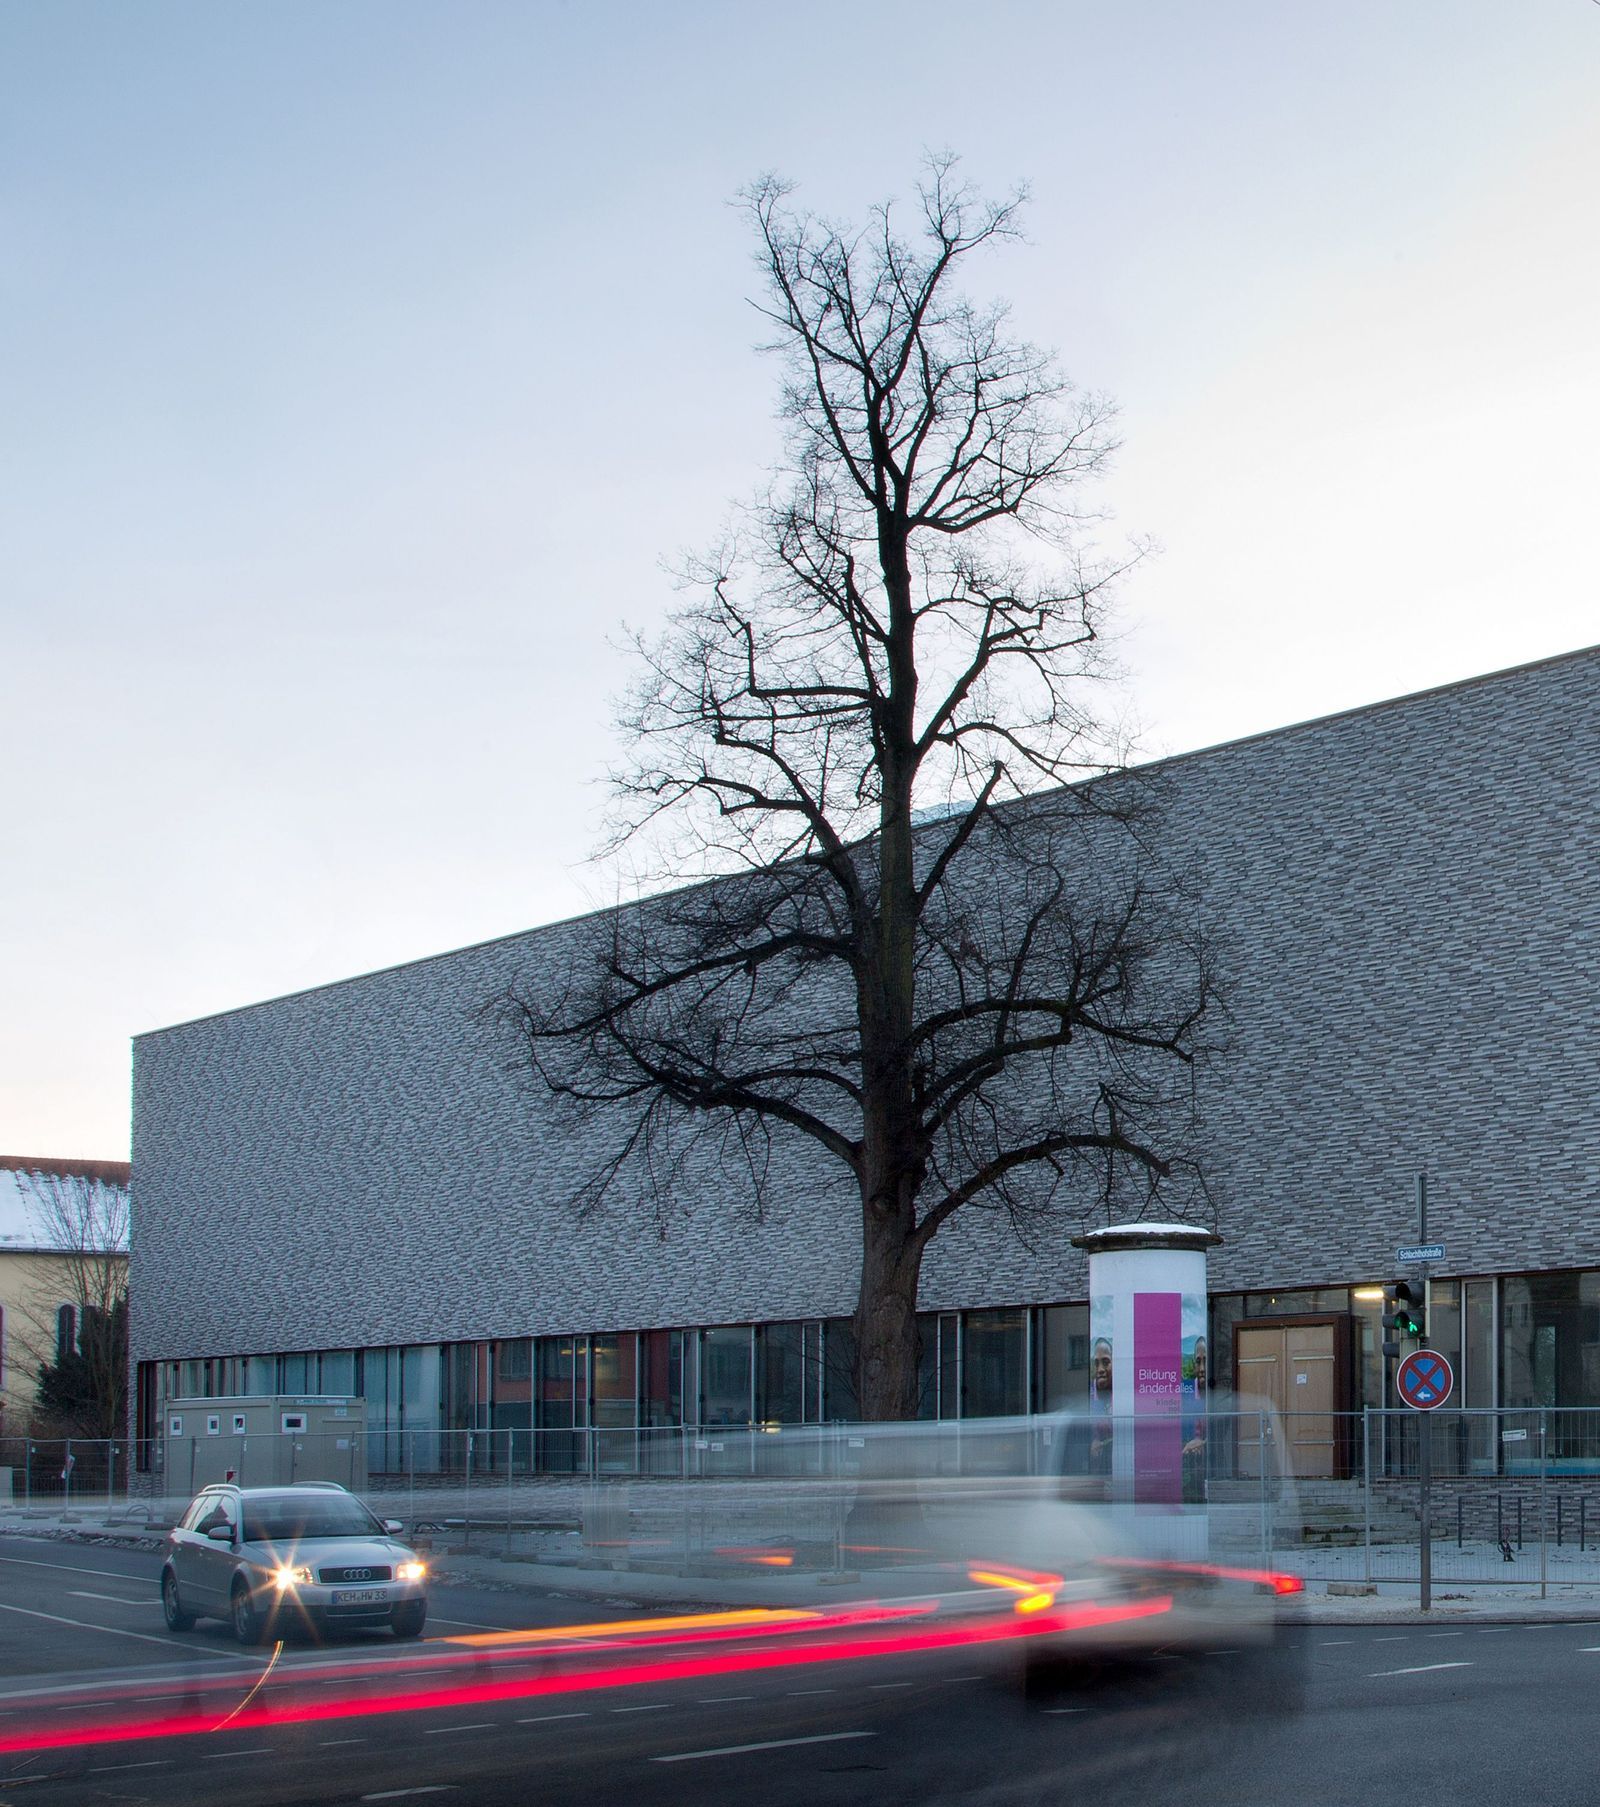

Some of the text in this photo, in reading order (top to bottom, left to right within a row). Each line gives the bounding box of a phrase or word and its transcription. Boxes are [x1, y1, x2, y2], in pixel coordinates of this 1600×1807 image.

[1139, 1369, 1177, 1382] Bildung
[1139, 1383, 1173, 1393] ändert
[336, 1591, 356, 1602] KEH
[361, 1591, 373, 1601] HW
